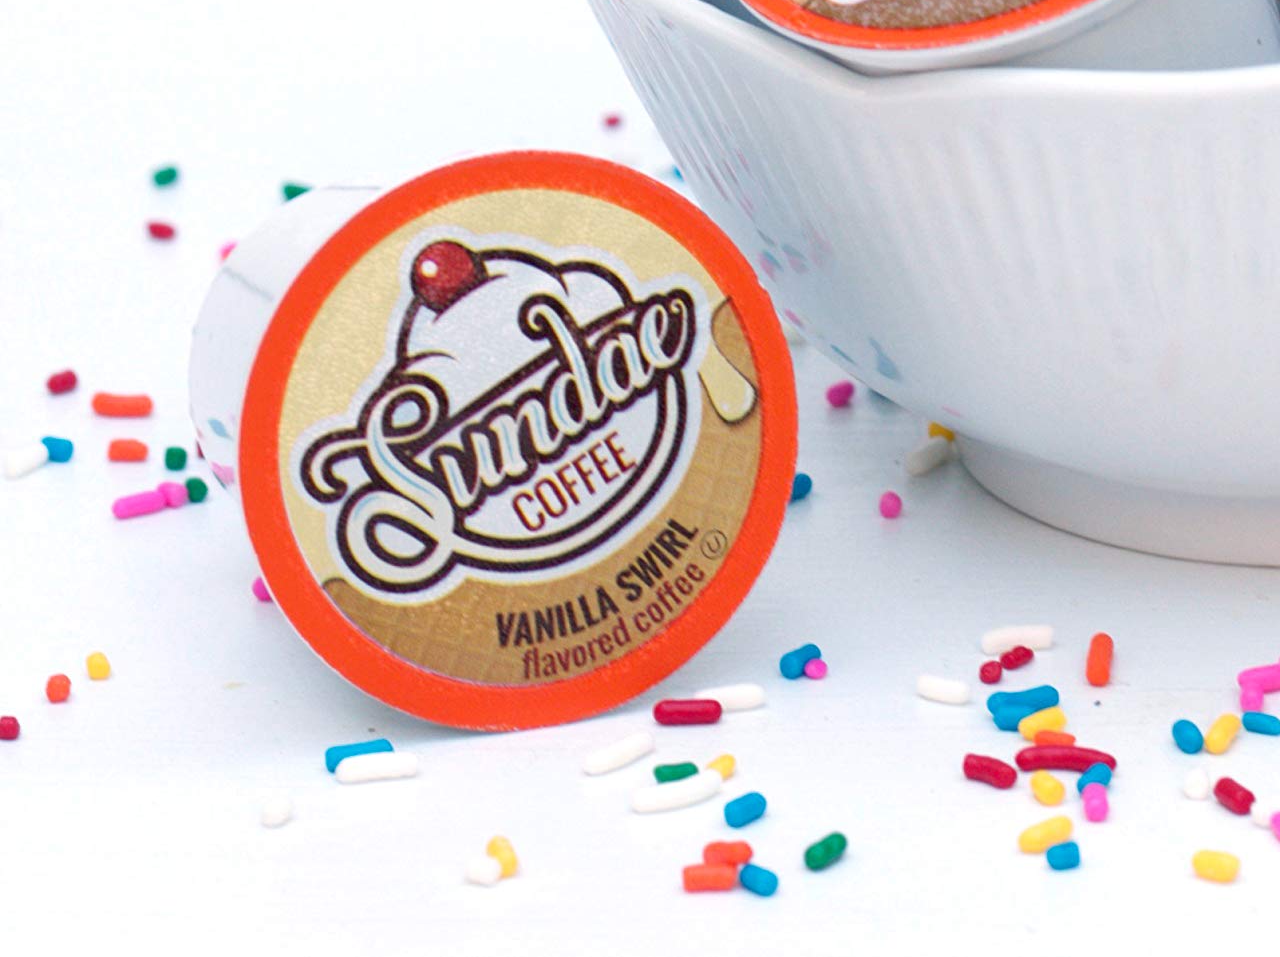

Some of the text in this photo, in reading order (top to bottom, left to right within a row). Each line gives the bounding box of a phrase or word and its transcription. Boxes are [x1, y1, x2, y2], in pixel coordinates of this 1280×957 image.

[303, 290, 692, 593] Sundae
[512, 431, 637, 532] COFFEE
[496, 518, 699, 649] VANILLA SWIRL
[522, 617, 632, 680] flavored
[632, 563, 705, 634] coffee
